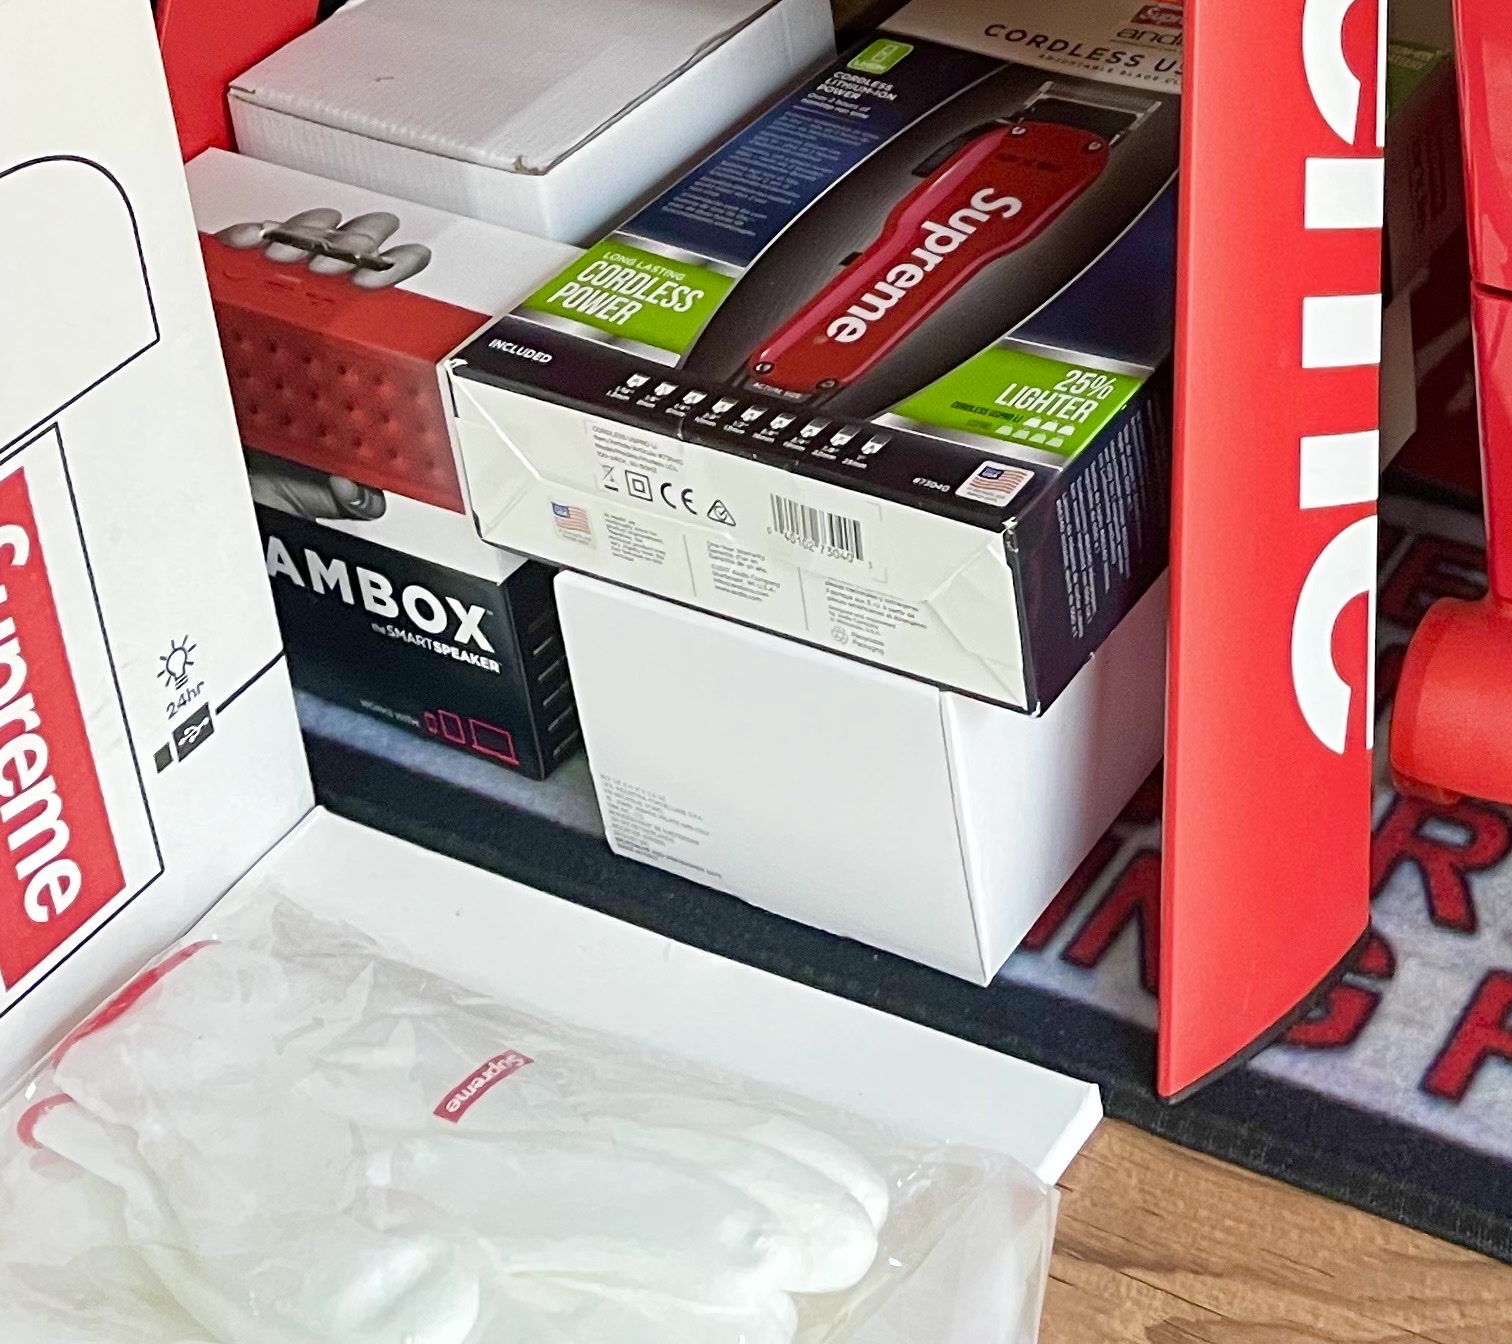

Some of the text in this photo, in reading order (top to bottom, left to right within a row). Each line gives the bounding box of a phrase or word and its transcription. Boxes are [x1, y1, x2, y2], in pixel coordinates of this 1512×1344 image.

[984, 23, 1146, 68] CORDLESS
[816, 83, 862, 100] POWER
[833, 71, 894, 92] CORDLESS
[577, 261, 705, 313] CORDLESS
[603, 251, 686, 281] LONG LASTING
[825, 185, 1023, 346] Supreme
[547, 281, 643, 326] POWER
[487, 338, 553, 365] INCLUDED
[994, 383, 1100, 424] LIGHTER
[1053, 368, 1117, 400] 25%
[912, 476, 950, 492] #73040
[265, 535, 495, 654] AMBOX
[386, 623, 501, 674] SMARTSPEAKER
[166, 677, 206, 721] 24hr
[445, 1054, 525, 1113] Supreme
